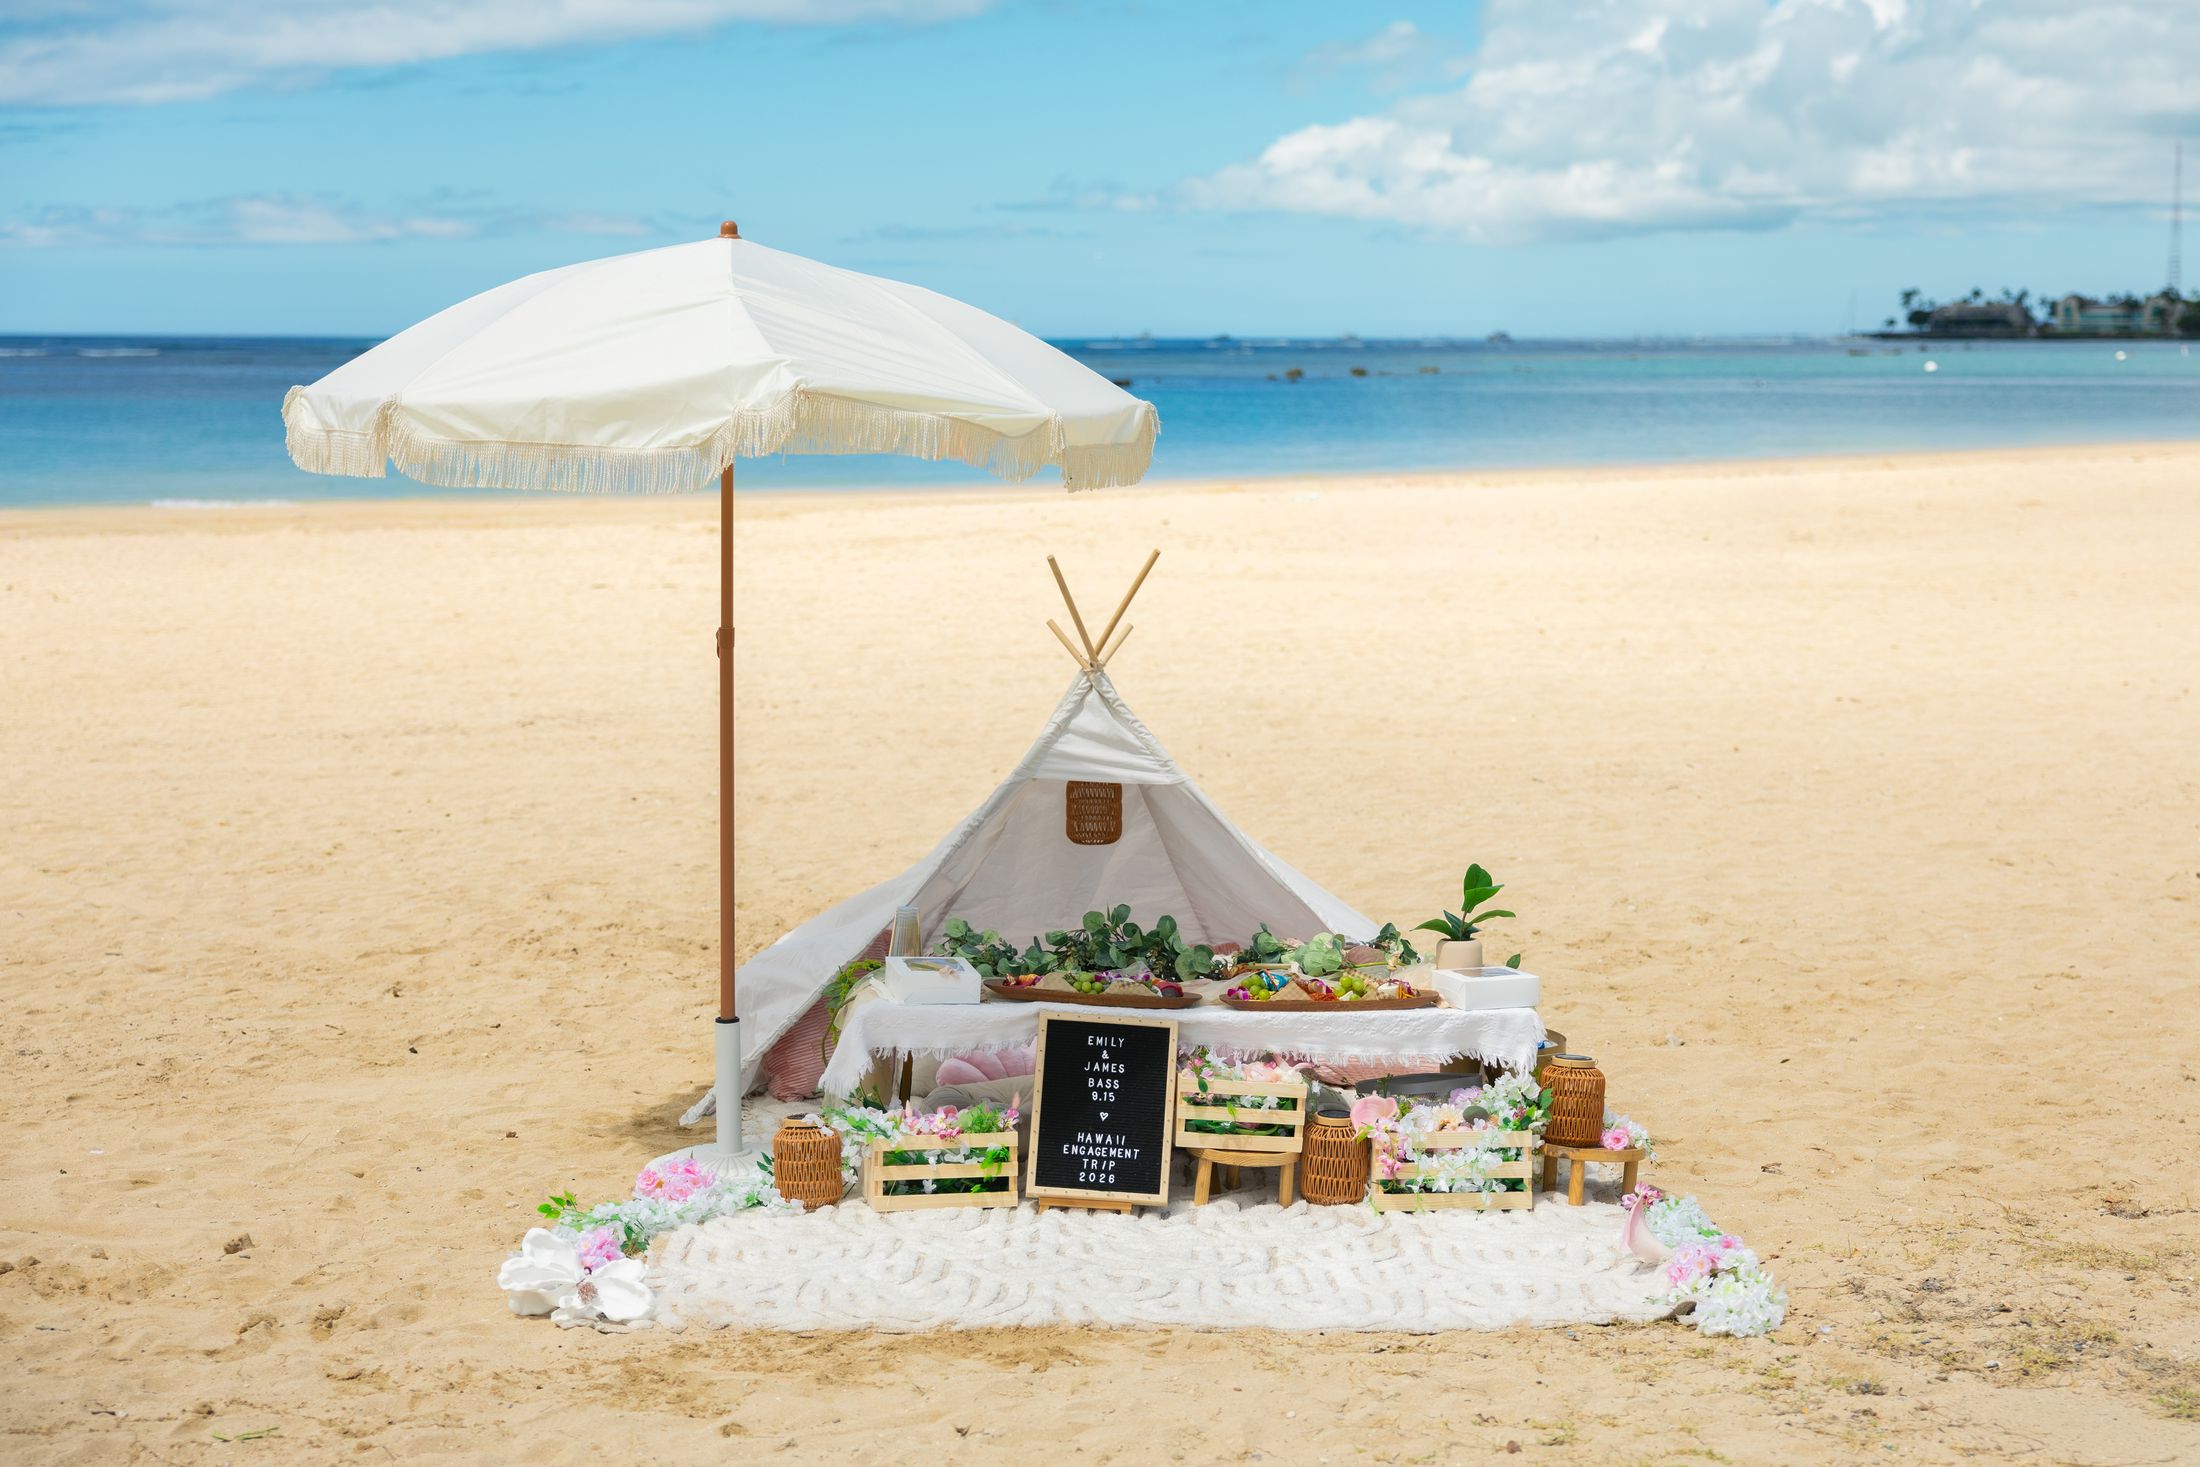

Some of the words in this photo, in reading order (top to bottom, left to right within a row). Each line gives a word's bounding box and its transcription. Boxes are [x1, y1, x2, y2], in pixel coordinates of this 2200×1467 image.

[1087, 1035, 1125, 1048] EMILY
[1101, 1049, 1110, 1059] &
[1084, 1061, 1125, 1074] JAMES
[1088, 1077, 1120, 1089] BASS
[1091, 1091, 1115, 1102] 9.15
[1077, 1132, 1126, 1145] HAWAII
[1062, 1144, 1140, 1159] ENGAGEMENT
[1082, 1158, 1116, 1171] TRIP
